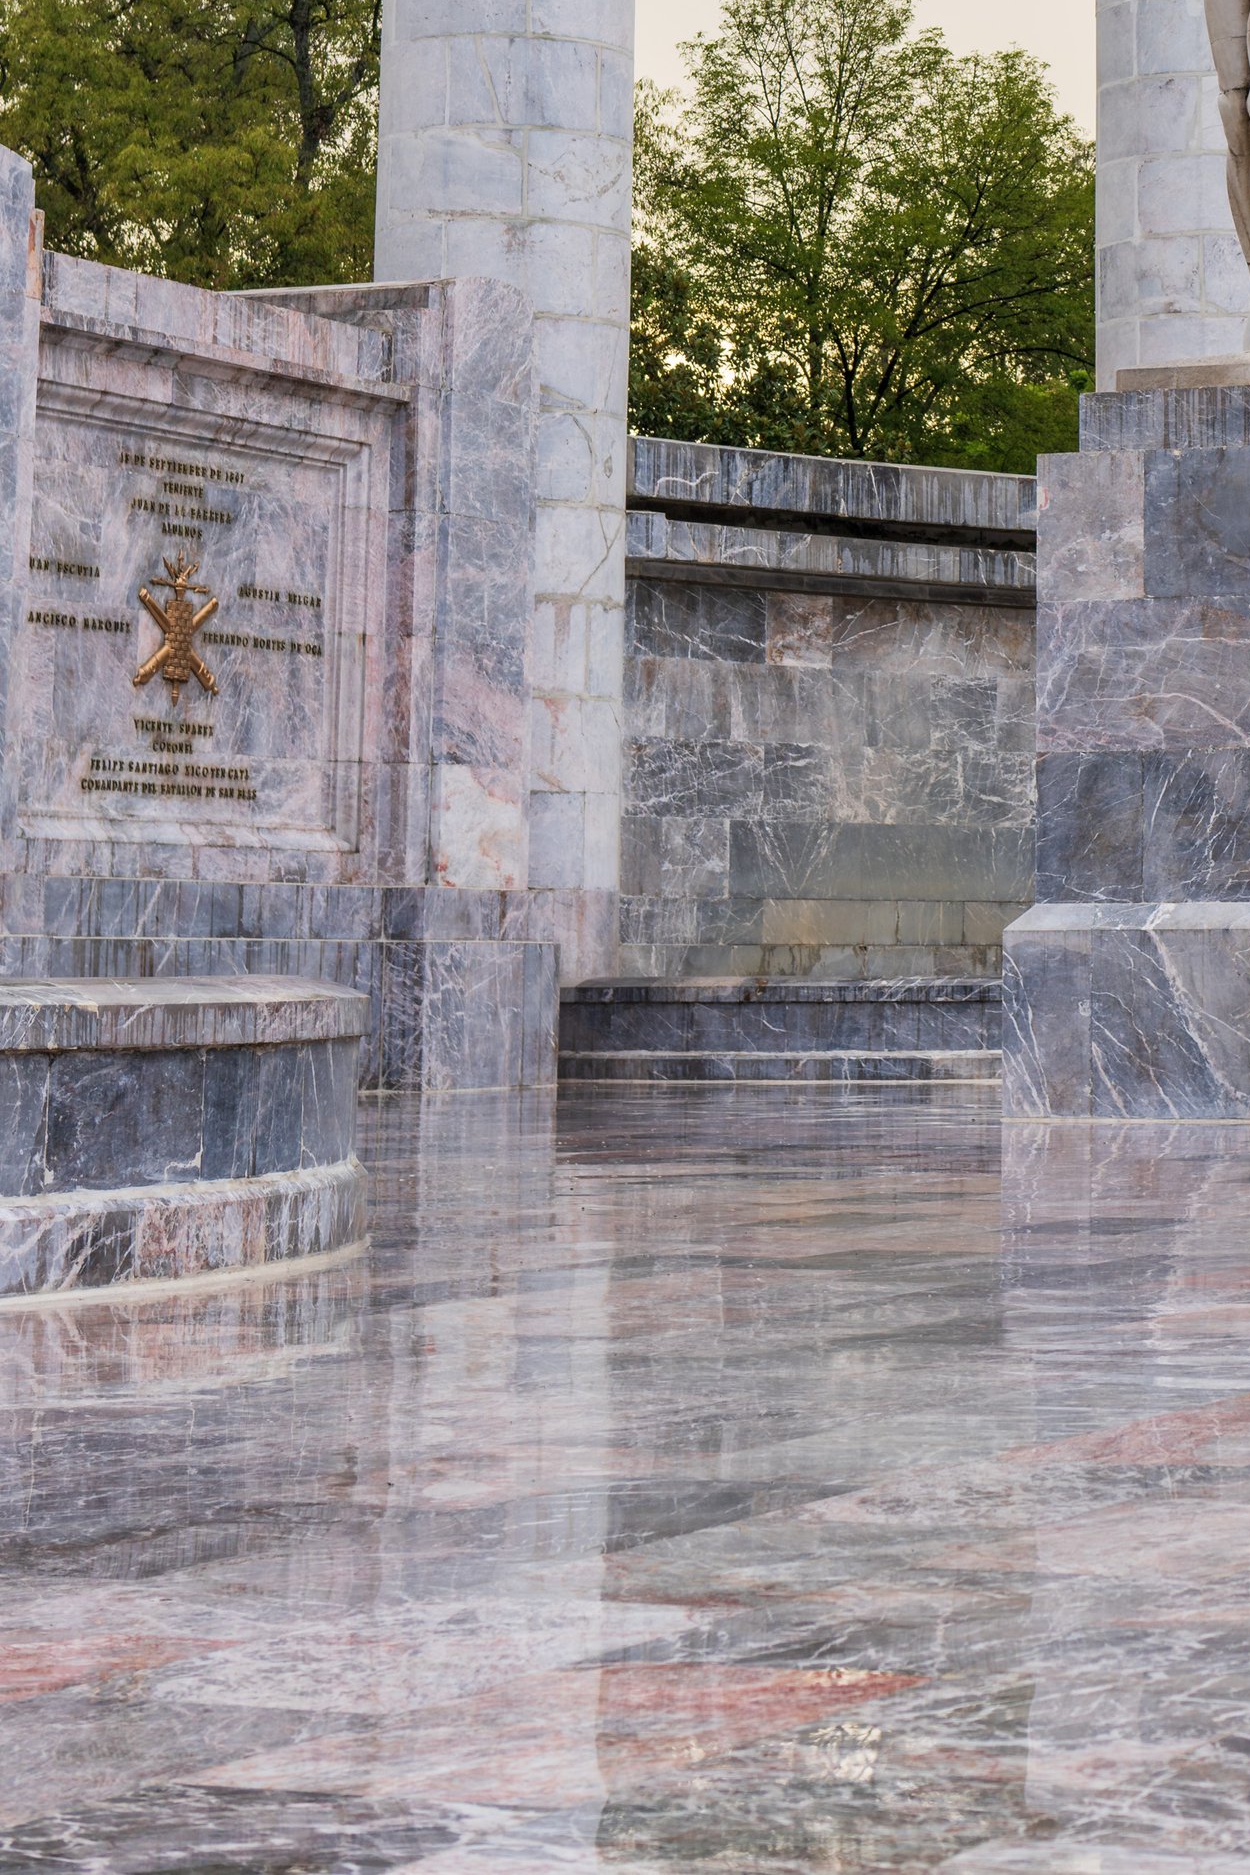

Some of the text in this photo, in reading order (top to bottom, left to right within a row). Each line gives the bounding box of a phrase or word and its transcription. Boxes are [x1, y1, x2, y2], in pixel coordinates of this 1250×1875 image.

[134, 454, 145, 466] DE
[149, 457, 207, 477] SEPTIEMBRE
[210, 467, 222, 480] DE
[163, 481, 204, 498] TENIENTE
[131, 498, 232, 524] JUAN DE LA BARRERA
[162, 522, 203, 539] ALUMNOS
[29, 556, 100, 578] UAN ESCUTIA
[238, 586, 322, 608] AGUSTIN MELGAR
[203, 632, 322, 657] FERNANDO MONTES DE OCA
[133, 718, 214, 737] VICENTE SUAREZ
[152, 742, 193, 754] CORONEL
[91, 758, 124, 772] FELIPE
[128, 761, 179, 776] SANTIAGO
[81, 778, 257, 801] COMANDANTE DEL BATALLON DE SAN BLAS
